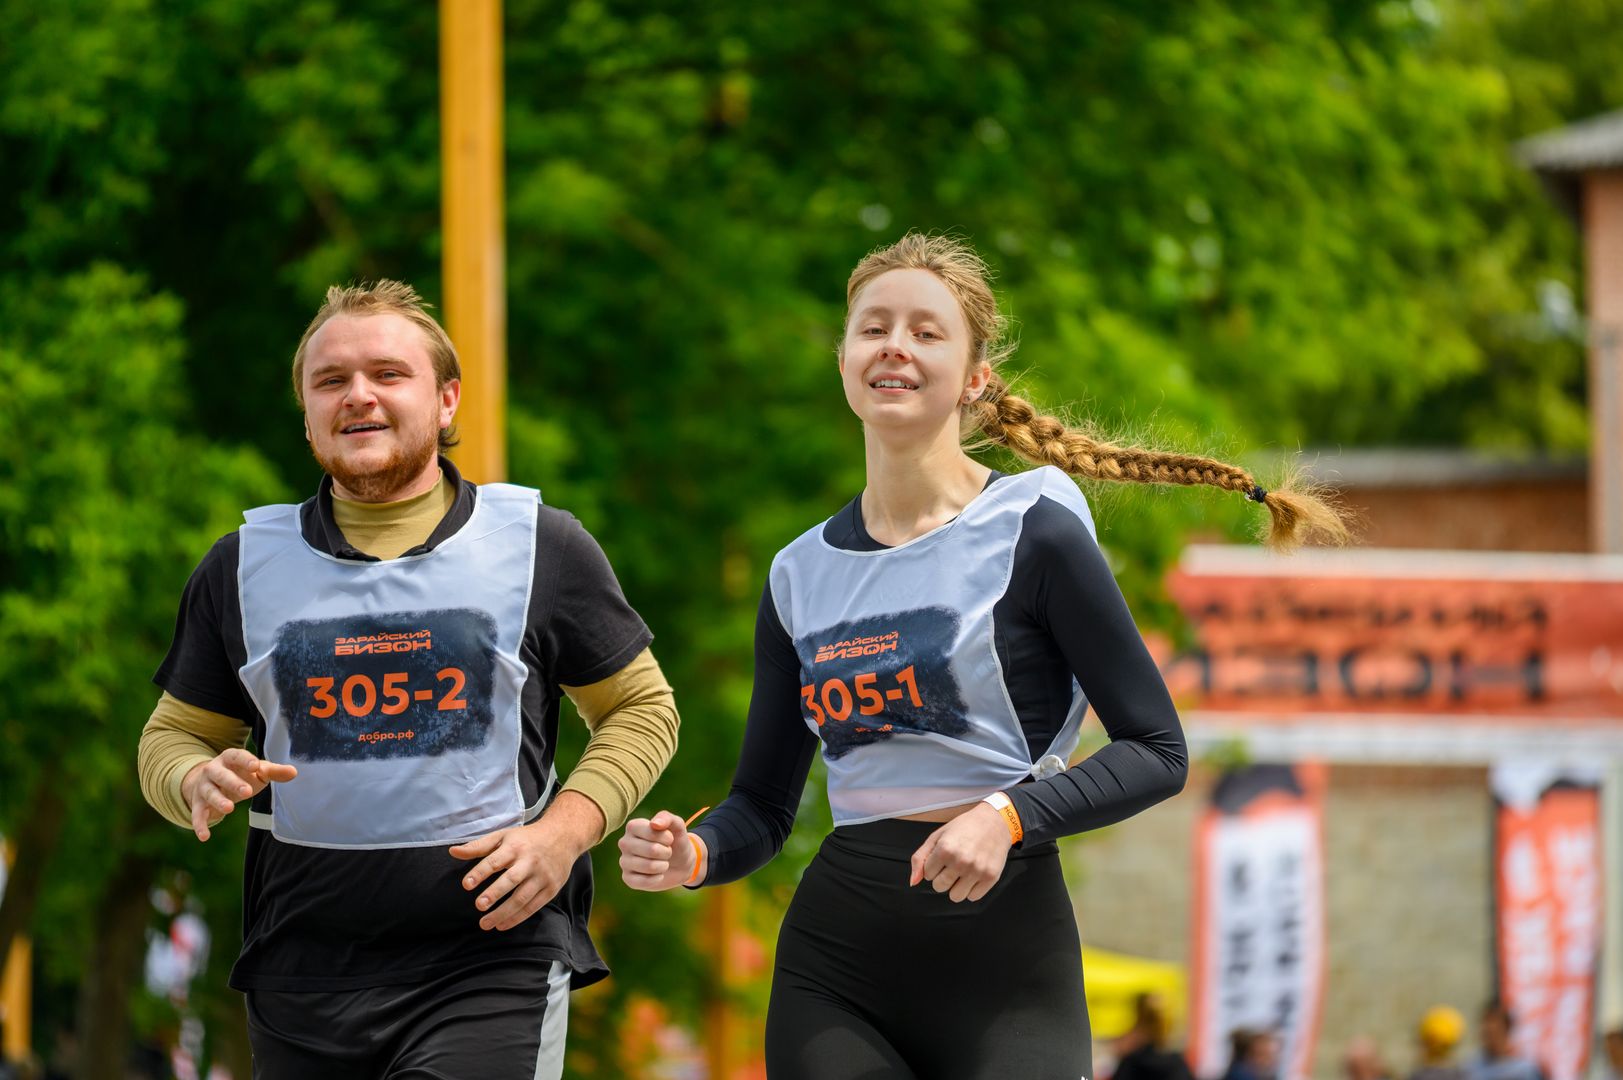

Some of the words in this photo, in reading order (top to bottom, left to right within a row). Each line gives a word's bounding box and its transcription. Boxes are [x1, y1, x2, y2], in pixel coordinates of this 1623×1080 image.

[334, 639, 432, 656] БИЗОН
[335, 629, 431, 644] ЗАРАЙСКИЙ
[817, 630, 899, 653] ЗАРАЙСКИЙ
[814, 640, 898, 664] БИЗОН
[306, 667, 467, 719] 305-2
[801, 665, 924, 727] 305-1
[358, 729, 415, 744] добро.рф
